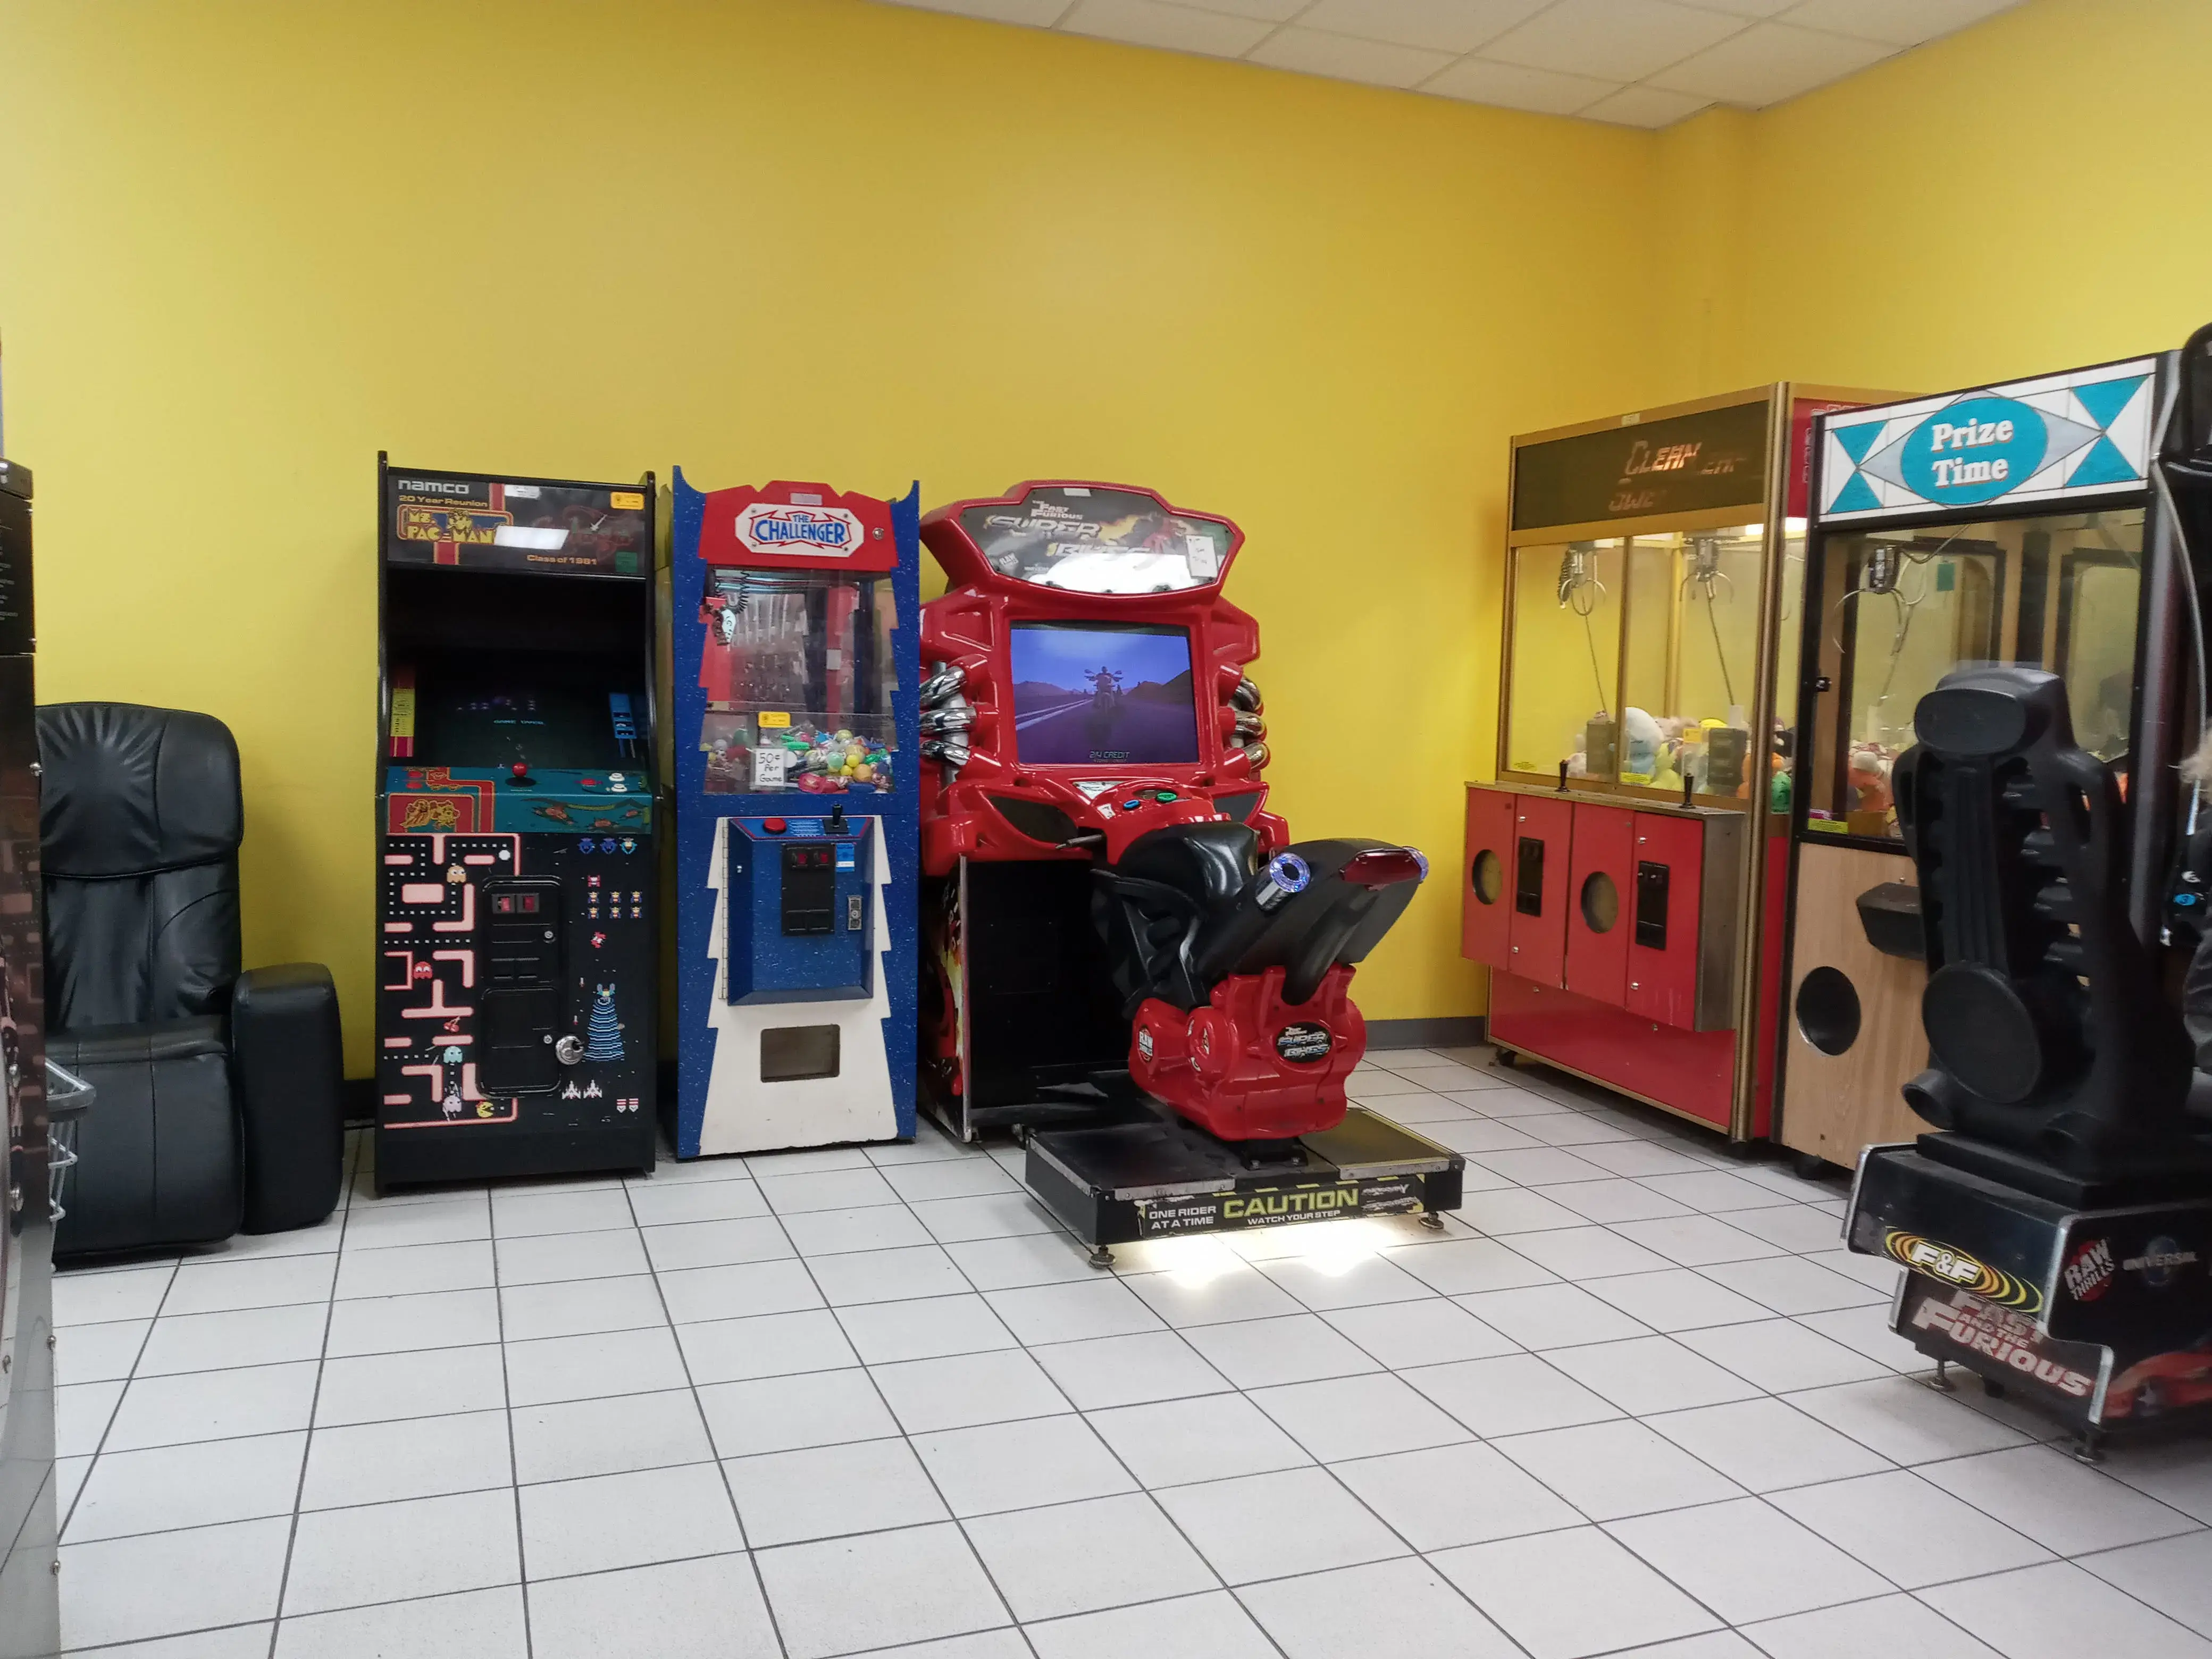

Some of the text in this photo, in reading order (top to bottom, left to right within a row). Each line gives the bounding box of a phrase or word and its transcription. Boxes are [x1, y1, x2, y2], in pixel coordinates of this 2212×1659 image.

[1930, 418, 2014, 452] Prize
[1931, 457, 2008, 488] Time
[398, 480, 469, 494] namco
[416, 496, 443, 505] Year
[445, 498, 488, 507] Reunion
[793, 514, 810, 523] THE
[1030, 508, 1083, 520] FURIOUS
[755, 519, 845, 543] CHALLENGER
[990, 515, 1101, 538] SUPER
[526, 554, 556, 563] Class
[569, 557, 597, 565] 1981
[759, 774, 783, 782] Game
[1277, 1033, 1327, 1046] SUPER
[1224, 1188, 1359, 1219] CAUTION
[1149, 1205, 1216, 1219] ONE RIDER
[1247, 1210, 1341, 1225] WATCH YOUR STEP
[1151, 1216, 1214, 1229] AT A TIME
[1909, 1242, 1981, 1281] F&F
[2064, 1238, 2112, 1290] RAW
[2070, 1258, 2115, 1301] THRILLS
[1912, 1296, 2093, 1397] FURIOUS
